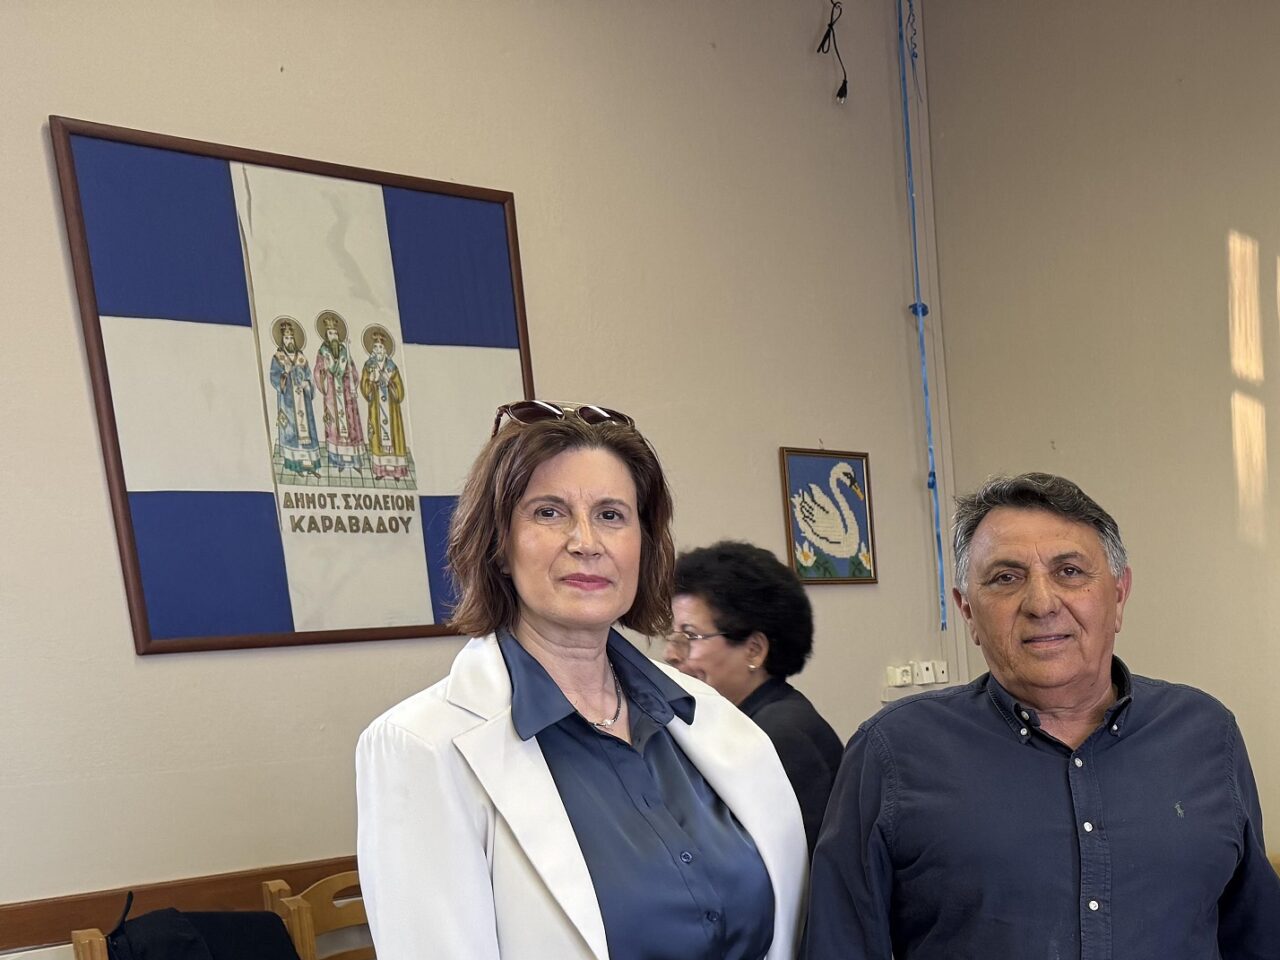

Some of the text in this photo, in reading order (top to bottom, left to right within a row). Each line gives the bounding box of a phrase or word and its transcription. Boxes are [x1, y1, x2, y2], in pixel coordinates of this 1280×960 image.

[283, 492, 416, 512] ΔΗΜΟΤ. ΣΧΟΛΕΙΟΝ
[289, 514, 413, 534] ΚΑΡΑΒΑΔΟΥ
